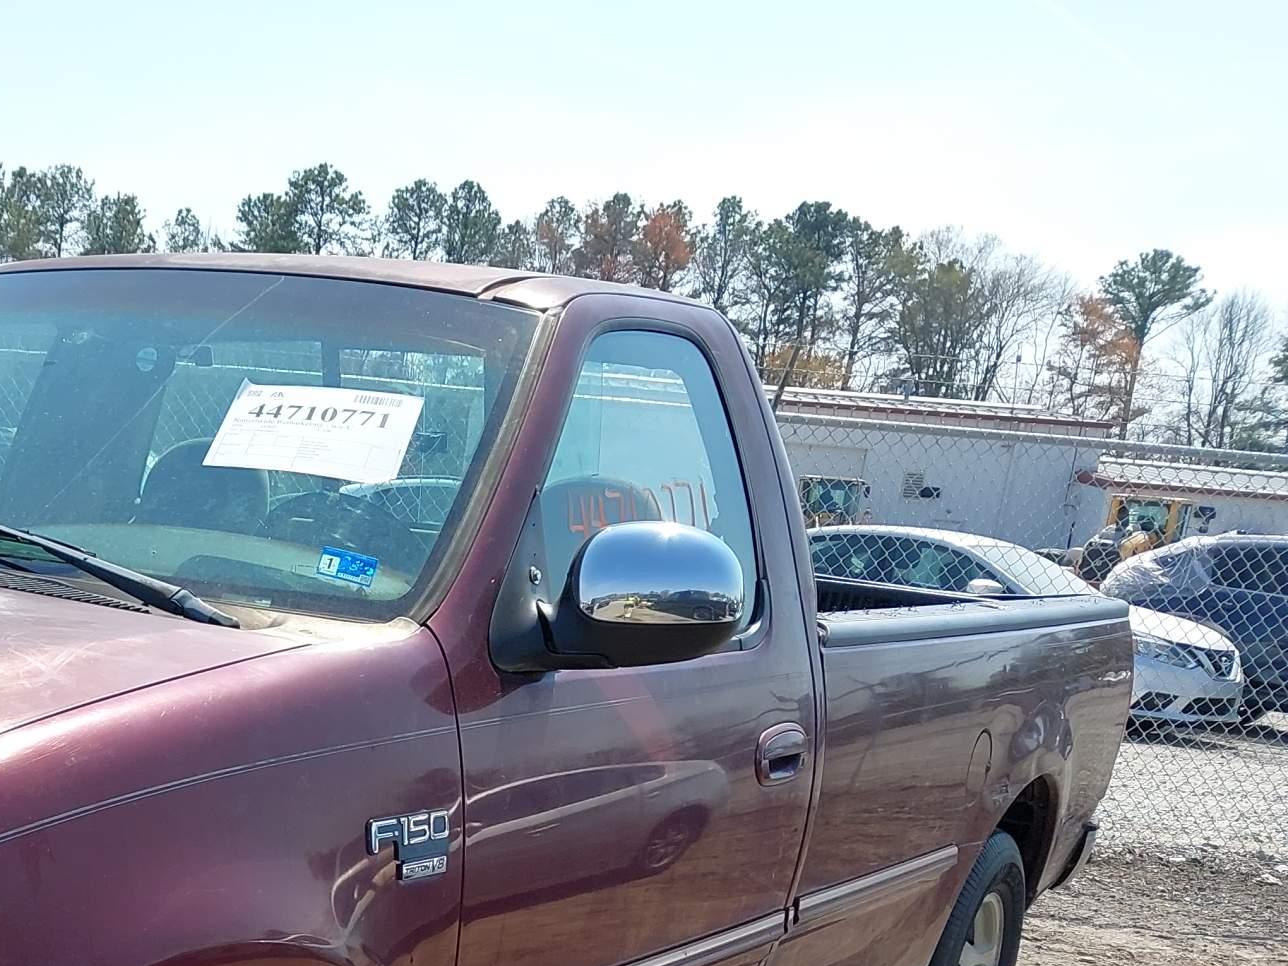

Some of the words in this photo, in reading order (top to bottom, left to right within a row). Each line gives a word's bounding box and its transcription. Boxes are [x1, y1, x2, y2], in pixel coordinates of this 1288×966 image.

[247, 403, 392, 429] 44710771
[327, 557, 334, 570] 1
[431, 858, 445, 873] V8
